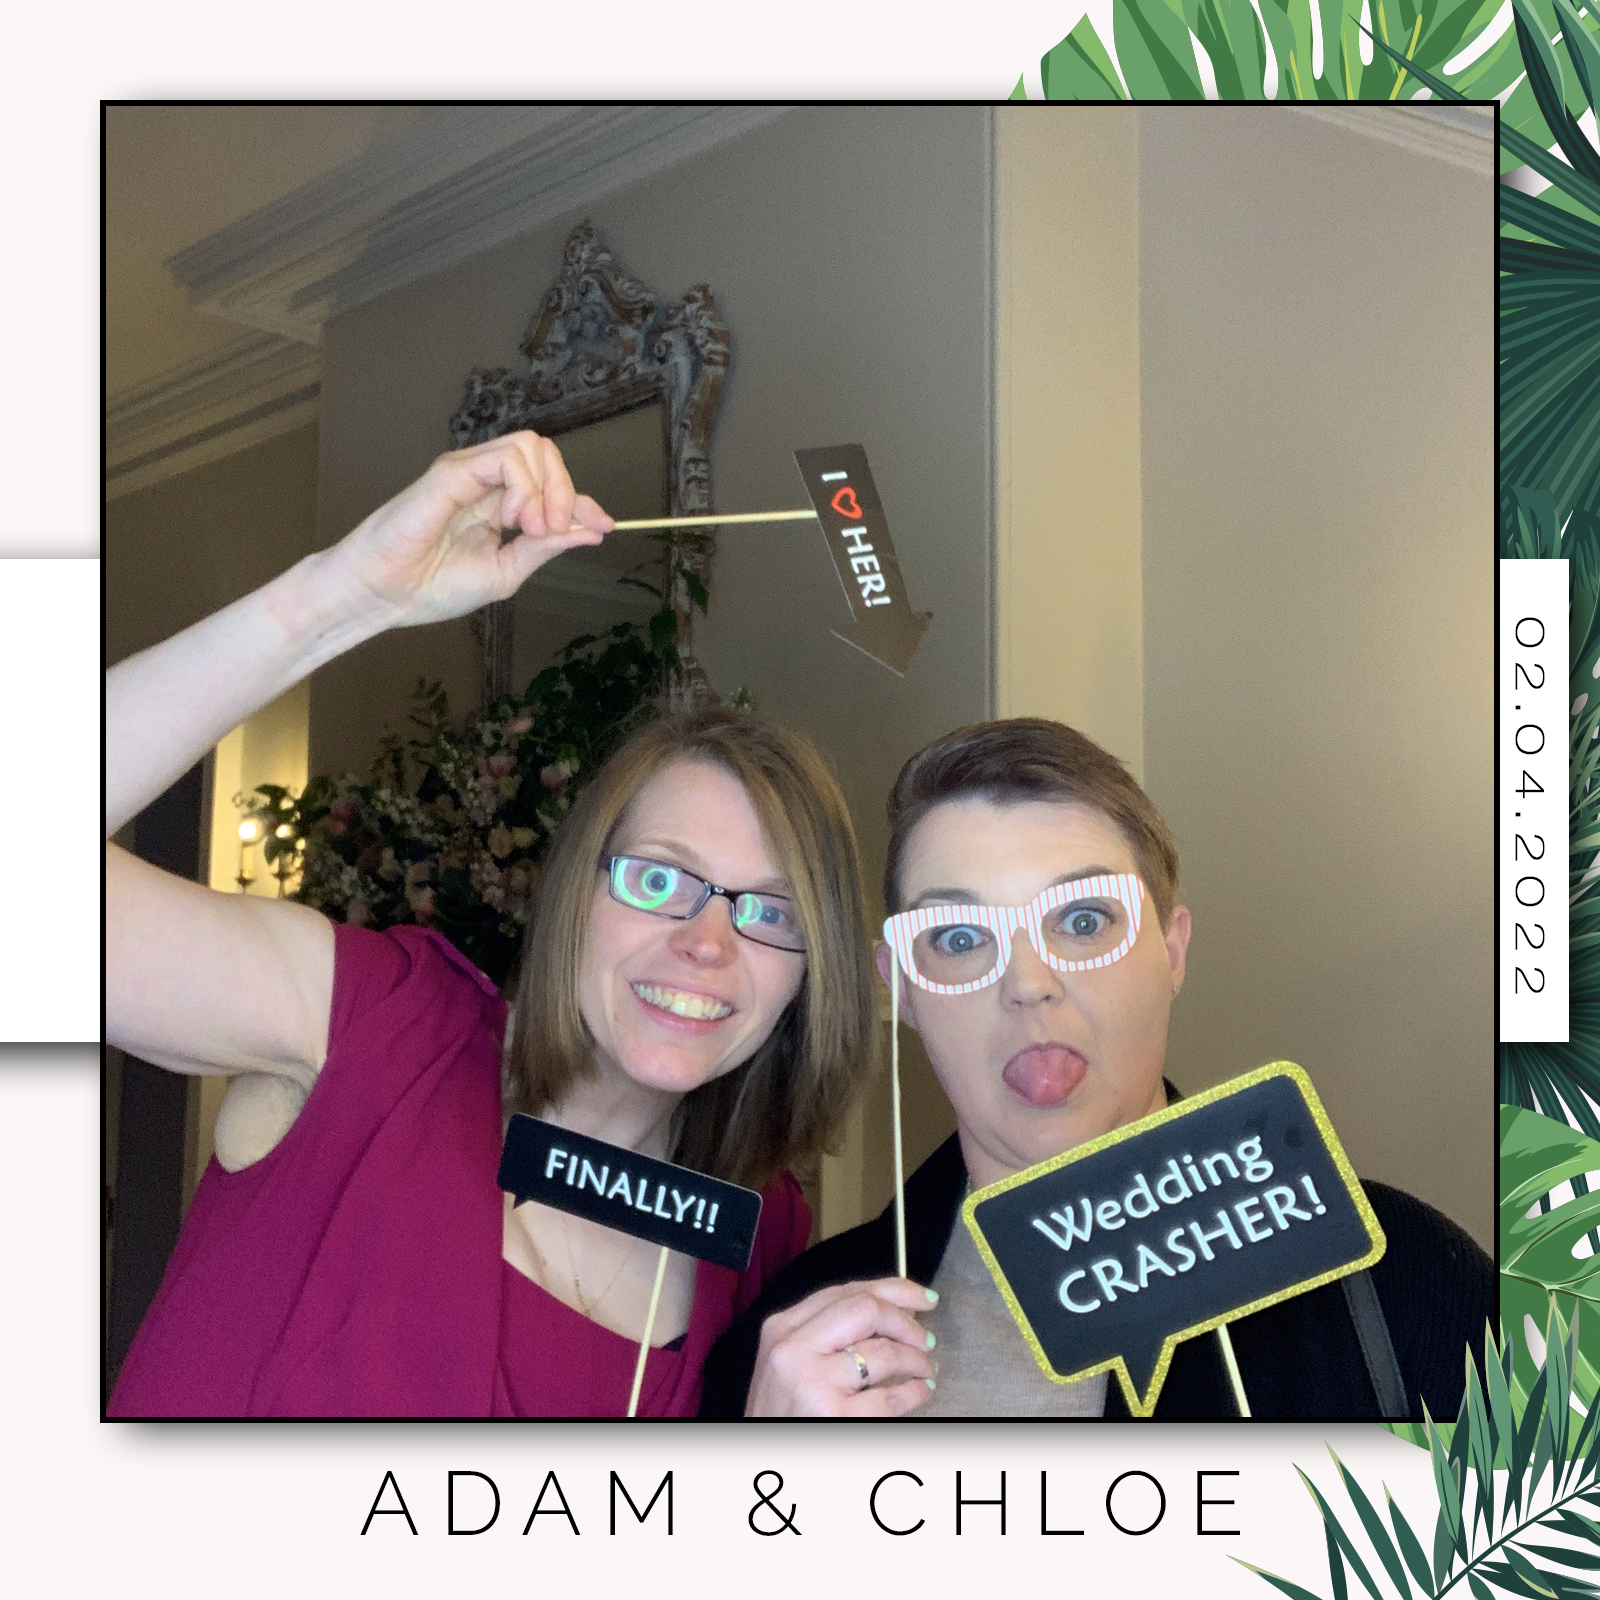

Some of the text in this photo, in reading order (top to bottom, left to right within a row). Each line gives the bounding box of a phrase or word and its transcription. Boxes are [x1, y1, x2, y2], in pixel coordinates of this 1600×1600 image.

[821, 470, 891, 608] I HER!
[545, 1147, 719, 1234] FINALLY!!
[1032, 1134, 1274, 1252] Wedding
[1057, 1174, 1328, 1314] CRASHER!
